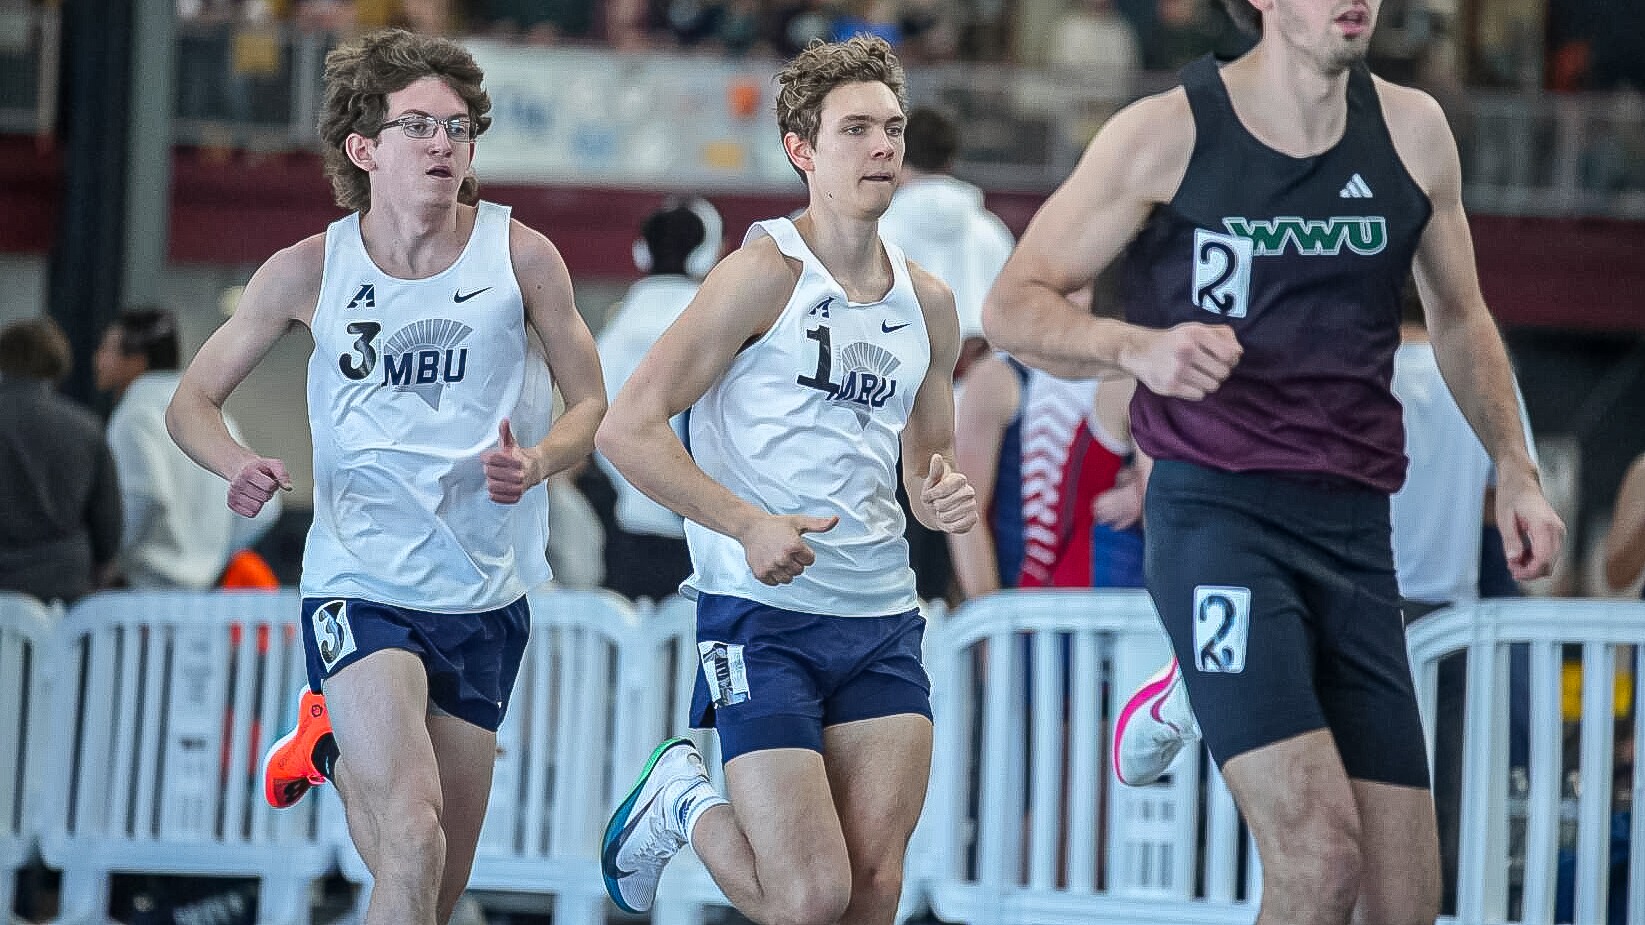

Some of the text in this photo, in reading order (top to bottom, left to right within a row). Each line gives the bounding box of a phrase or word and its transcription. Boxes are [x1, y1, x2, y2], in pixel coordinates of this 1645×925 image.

[1222, 216, 1387, 255] WWU
[1199, 242, 1236, 314] 2
[338, 322, 381, 380] 3
[381, 348, 468, 387] MBU
[797, 325, 840, 394] 1
[825, 370, 897, 408] MBU
[319, 602, 344, 664] 3
[1200, 595, 1236, 669] 2
